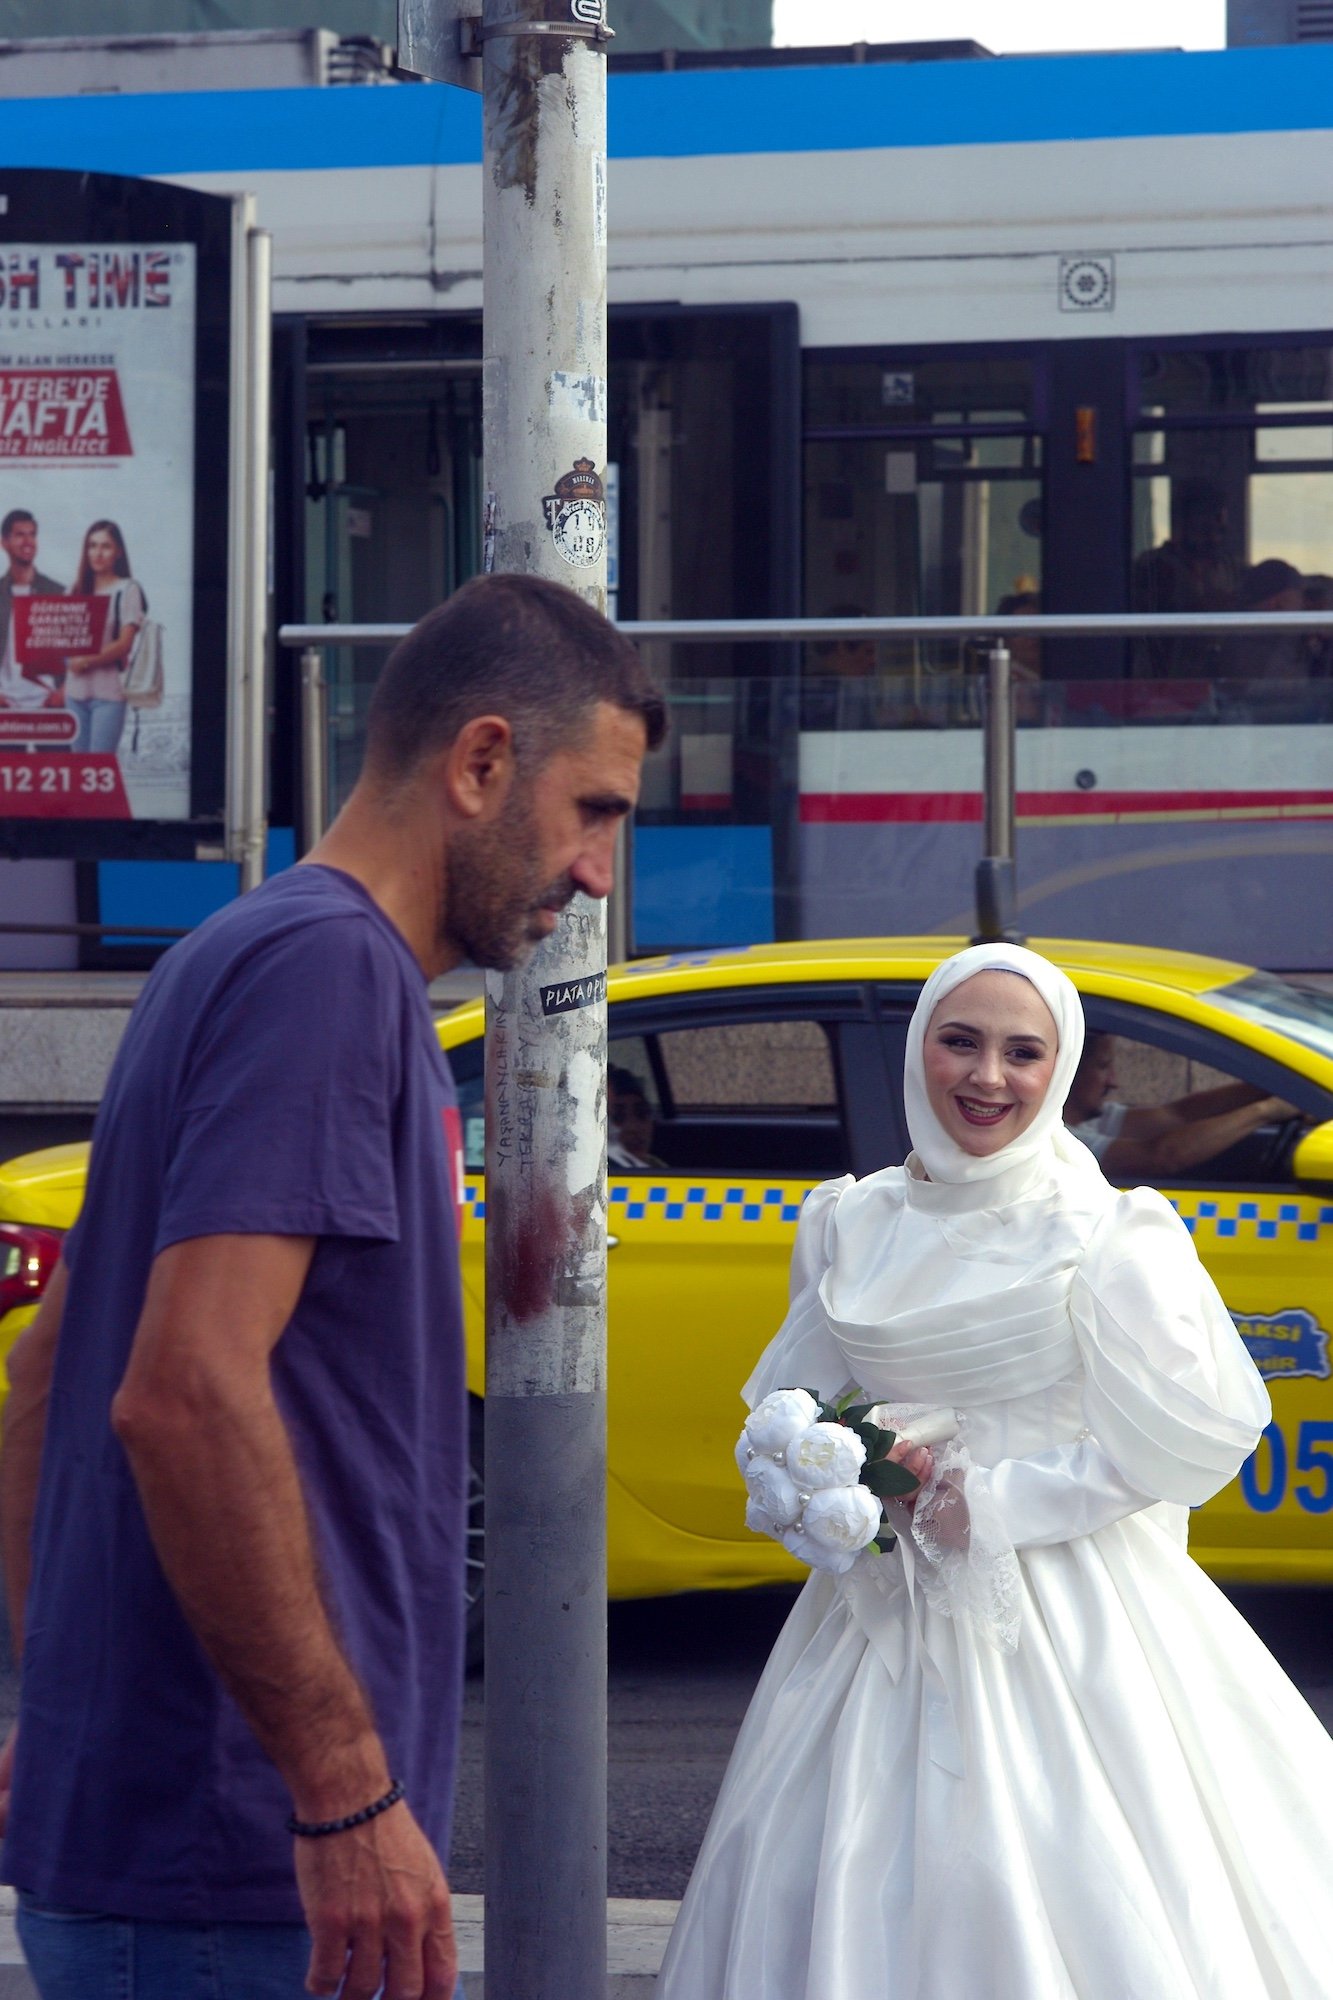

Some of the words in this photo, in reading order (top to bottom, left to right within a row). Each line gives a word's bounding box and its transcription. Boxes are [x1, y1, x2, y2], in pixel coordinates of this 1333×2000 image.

[0, 253, 39, 310] H
[56, 253, 171, 309] TIME
[0, 317, 101, 328] ULLARI
[0, 401, 108, 437] AFTA
[1, 766, 33, 792] 12
[39, 766, 71, 792] 21
[81, 766, 116, 793] 33
[546, 983, 585, 1007] PLATA
